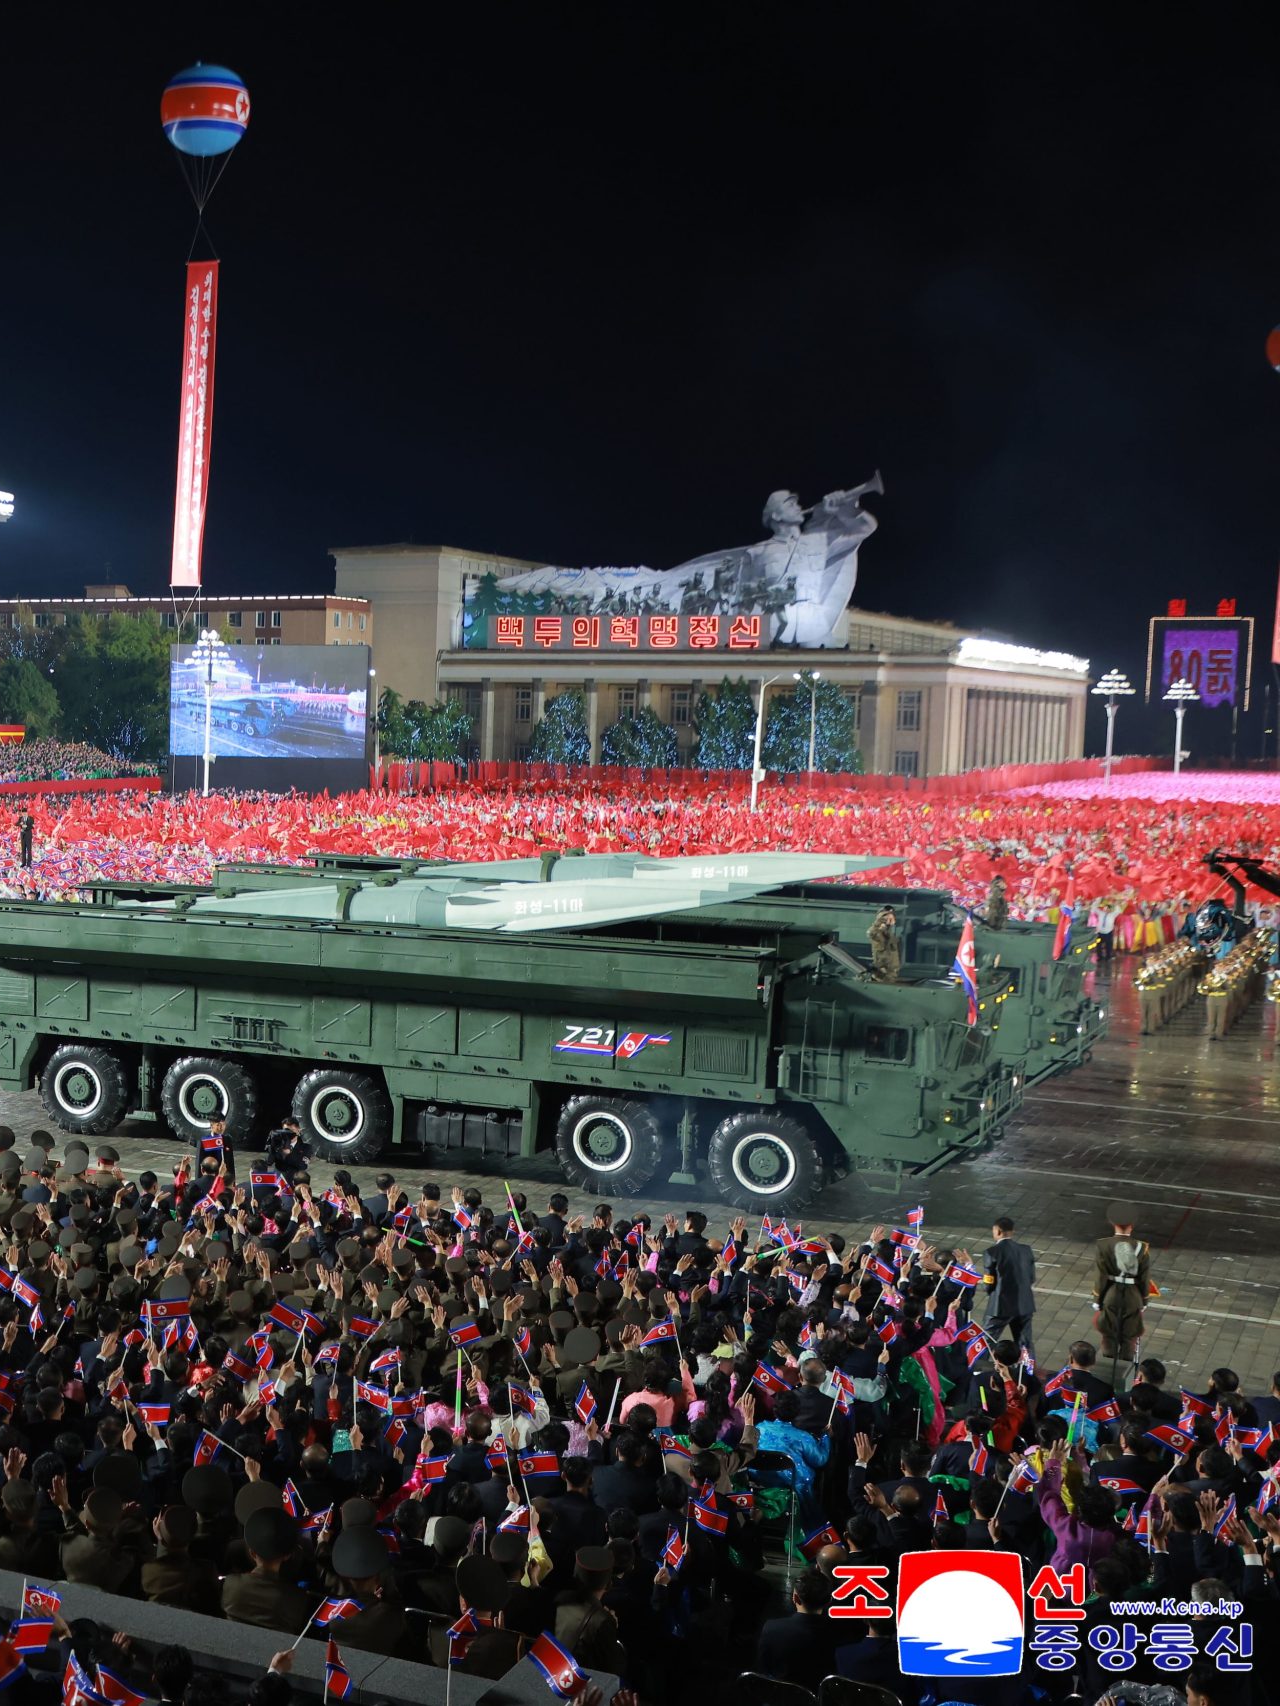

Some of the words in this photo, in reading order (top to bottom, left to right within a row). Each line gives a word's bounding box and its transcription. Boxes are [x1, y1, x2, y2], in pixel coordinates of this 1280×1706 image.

[691, 865, 749, 879] 화성-11마
[514, 899, 583, 915] 화성-11마
[562, 1025, 616, 1046] 721
